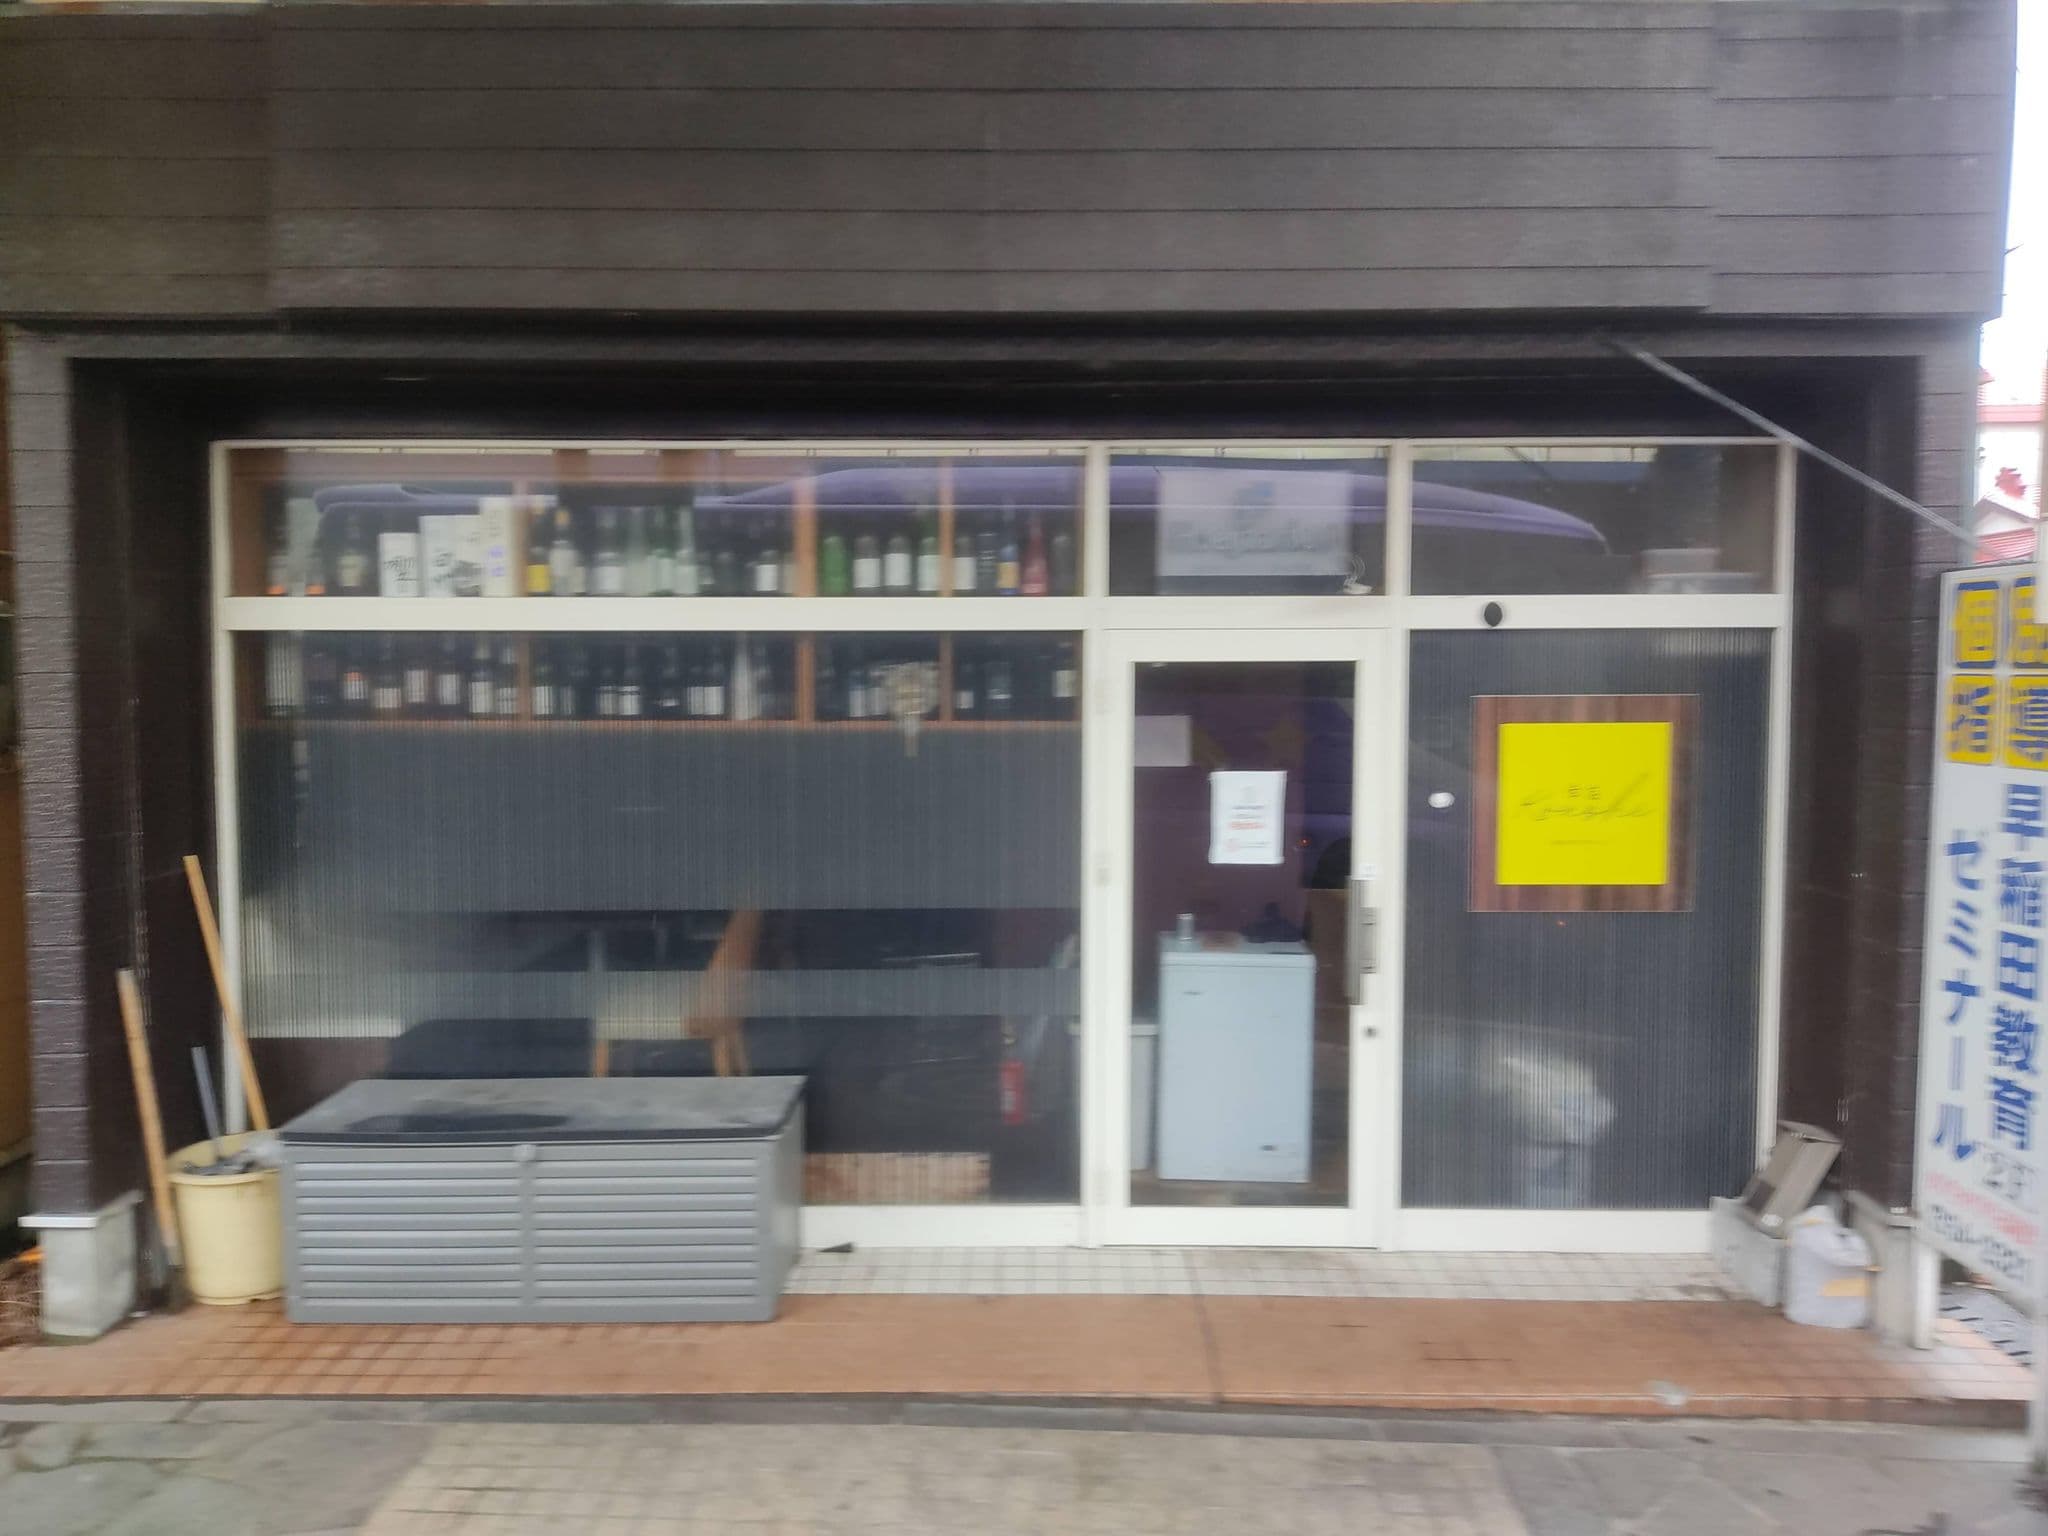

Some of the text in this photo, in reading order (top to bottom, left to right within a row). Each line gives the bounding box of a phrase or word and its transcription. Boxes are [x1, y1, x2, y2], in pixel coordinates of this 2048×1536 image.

[1932, 829, 1988, 1159] ゼミナール
